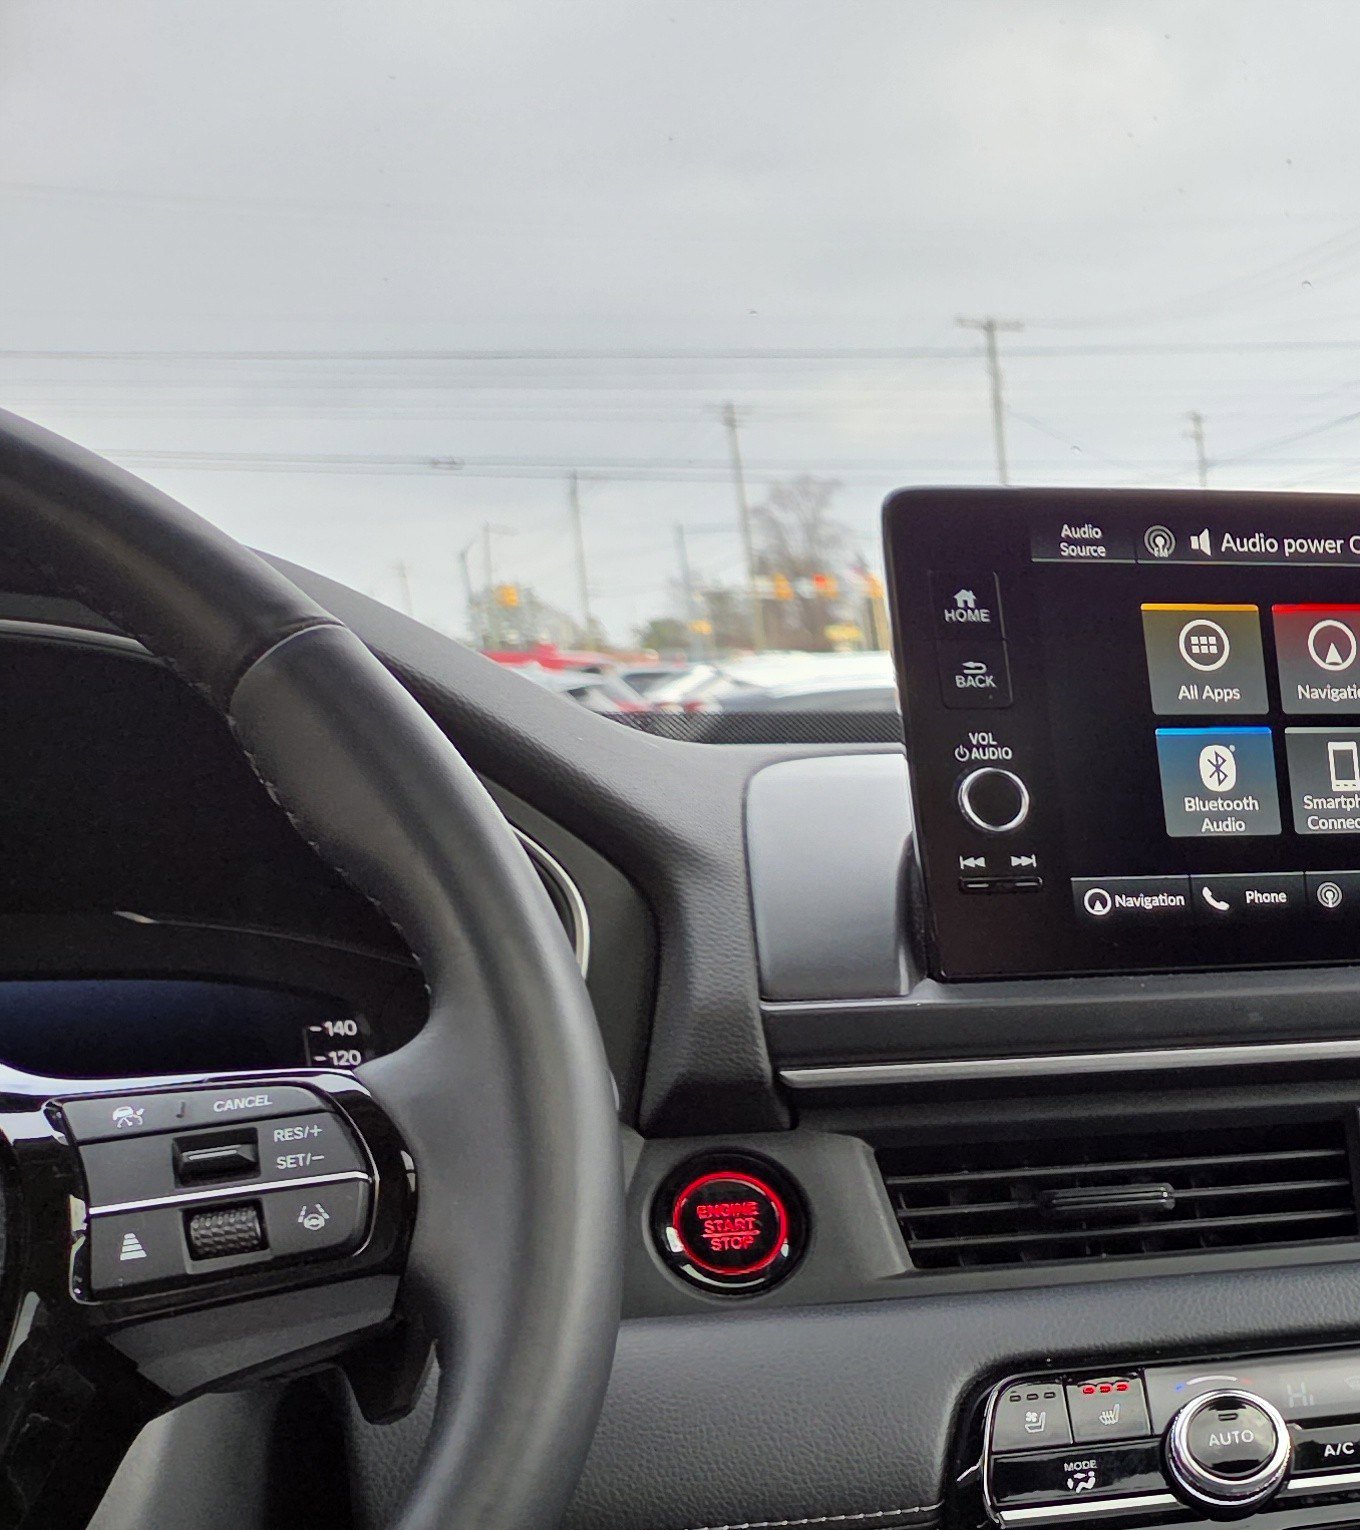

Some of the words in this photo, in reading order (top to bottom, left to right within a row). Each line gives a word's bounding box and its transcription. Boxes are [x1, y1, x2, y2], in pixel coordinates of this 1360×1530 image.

[1061, 524, 1102, 539] Audio
[1060, 542, 1106, 557] Source
[1221, 533, 1278, 553] Audio
[1283, 537, 1343, 556] power
[945, 609, 990, 623] HOME
[955, 675, 996, 688] BACK
[1178, 685, 1198, 700] All
[1202, 686, 1241, 702] Apps
[969, 732, 997, 745] VOL
[971, 747, 1013, 760] AUDIO
[1184, 796, 1259, 811] Bluetooth
[1201, 817, 1246, 832] Audio
[1114, 892, 1185, 909] Navigation
[1245, 890, 1287, 904] Phone
[324, 1020, 357, 1036] 140
[329, 1050, 361, 1066] 120
[213, 1094, 273, 1112] CANCEL
[273, 1124, 323, 1143] RES/+
[276, 1153, 325, 1169] SET/-
[697, 1202, 759, 1219] ENGINE
[704, 1217, 757, 1233] START
[711, 1236, 754, 1251] STOP
[1209, 1429, 1255, 1447] AUTO
[1324, 1442, 1355, 1457] A/C
[1064, 1460, 1097, 1472] MODE
